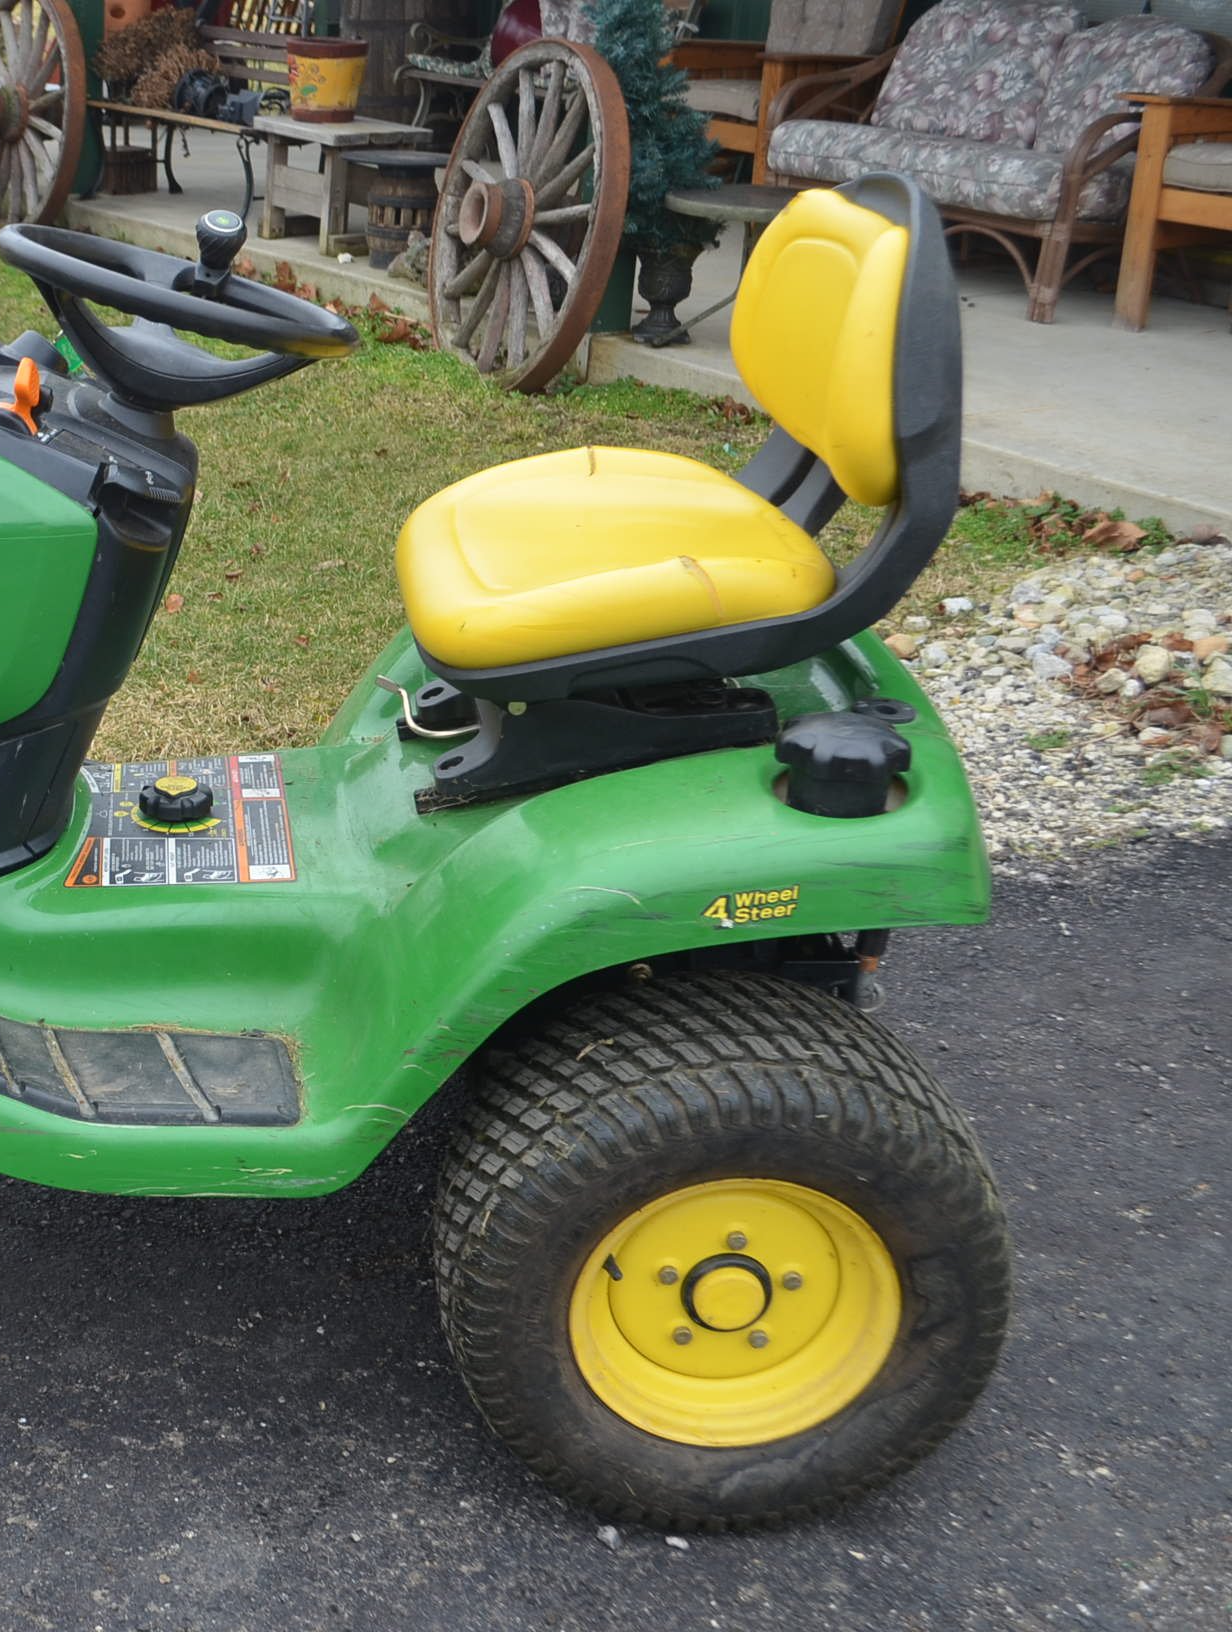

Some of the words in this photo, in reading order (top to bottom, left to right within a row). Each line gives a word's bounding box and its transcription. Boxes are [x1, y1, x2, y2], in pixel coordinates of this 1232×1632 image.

[701, 894, 732, 928] 4
[734, 885, 800, 908] Wheel
[733, 902, 798, 924] Steer
